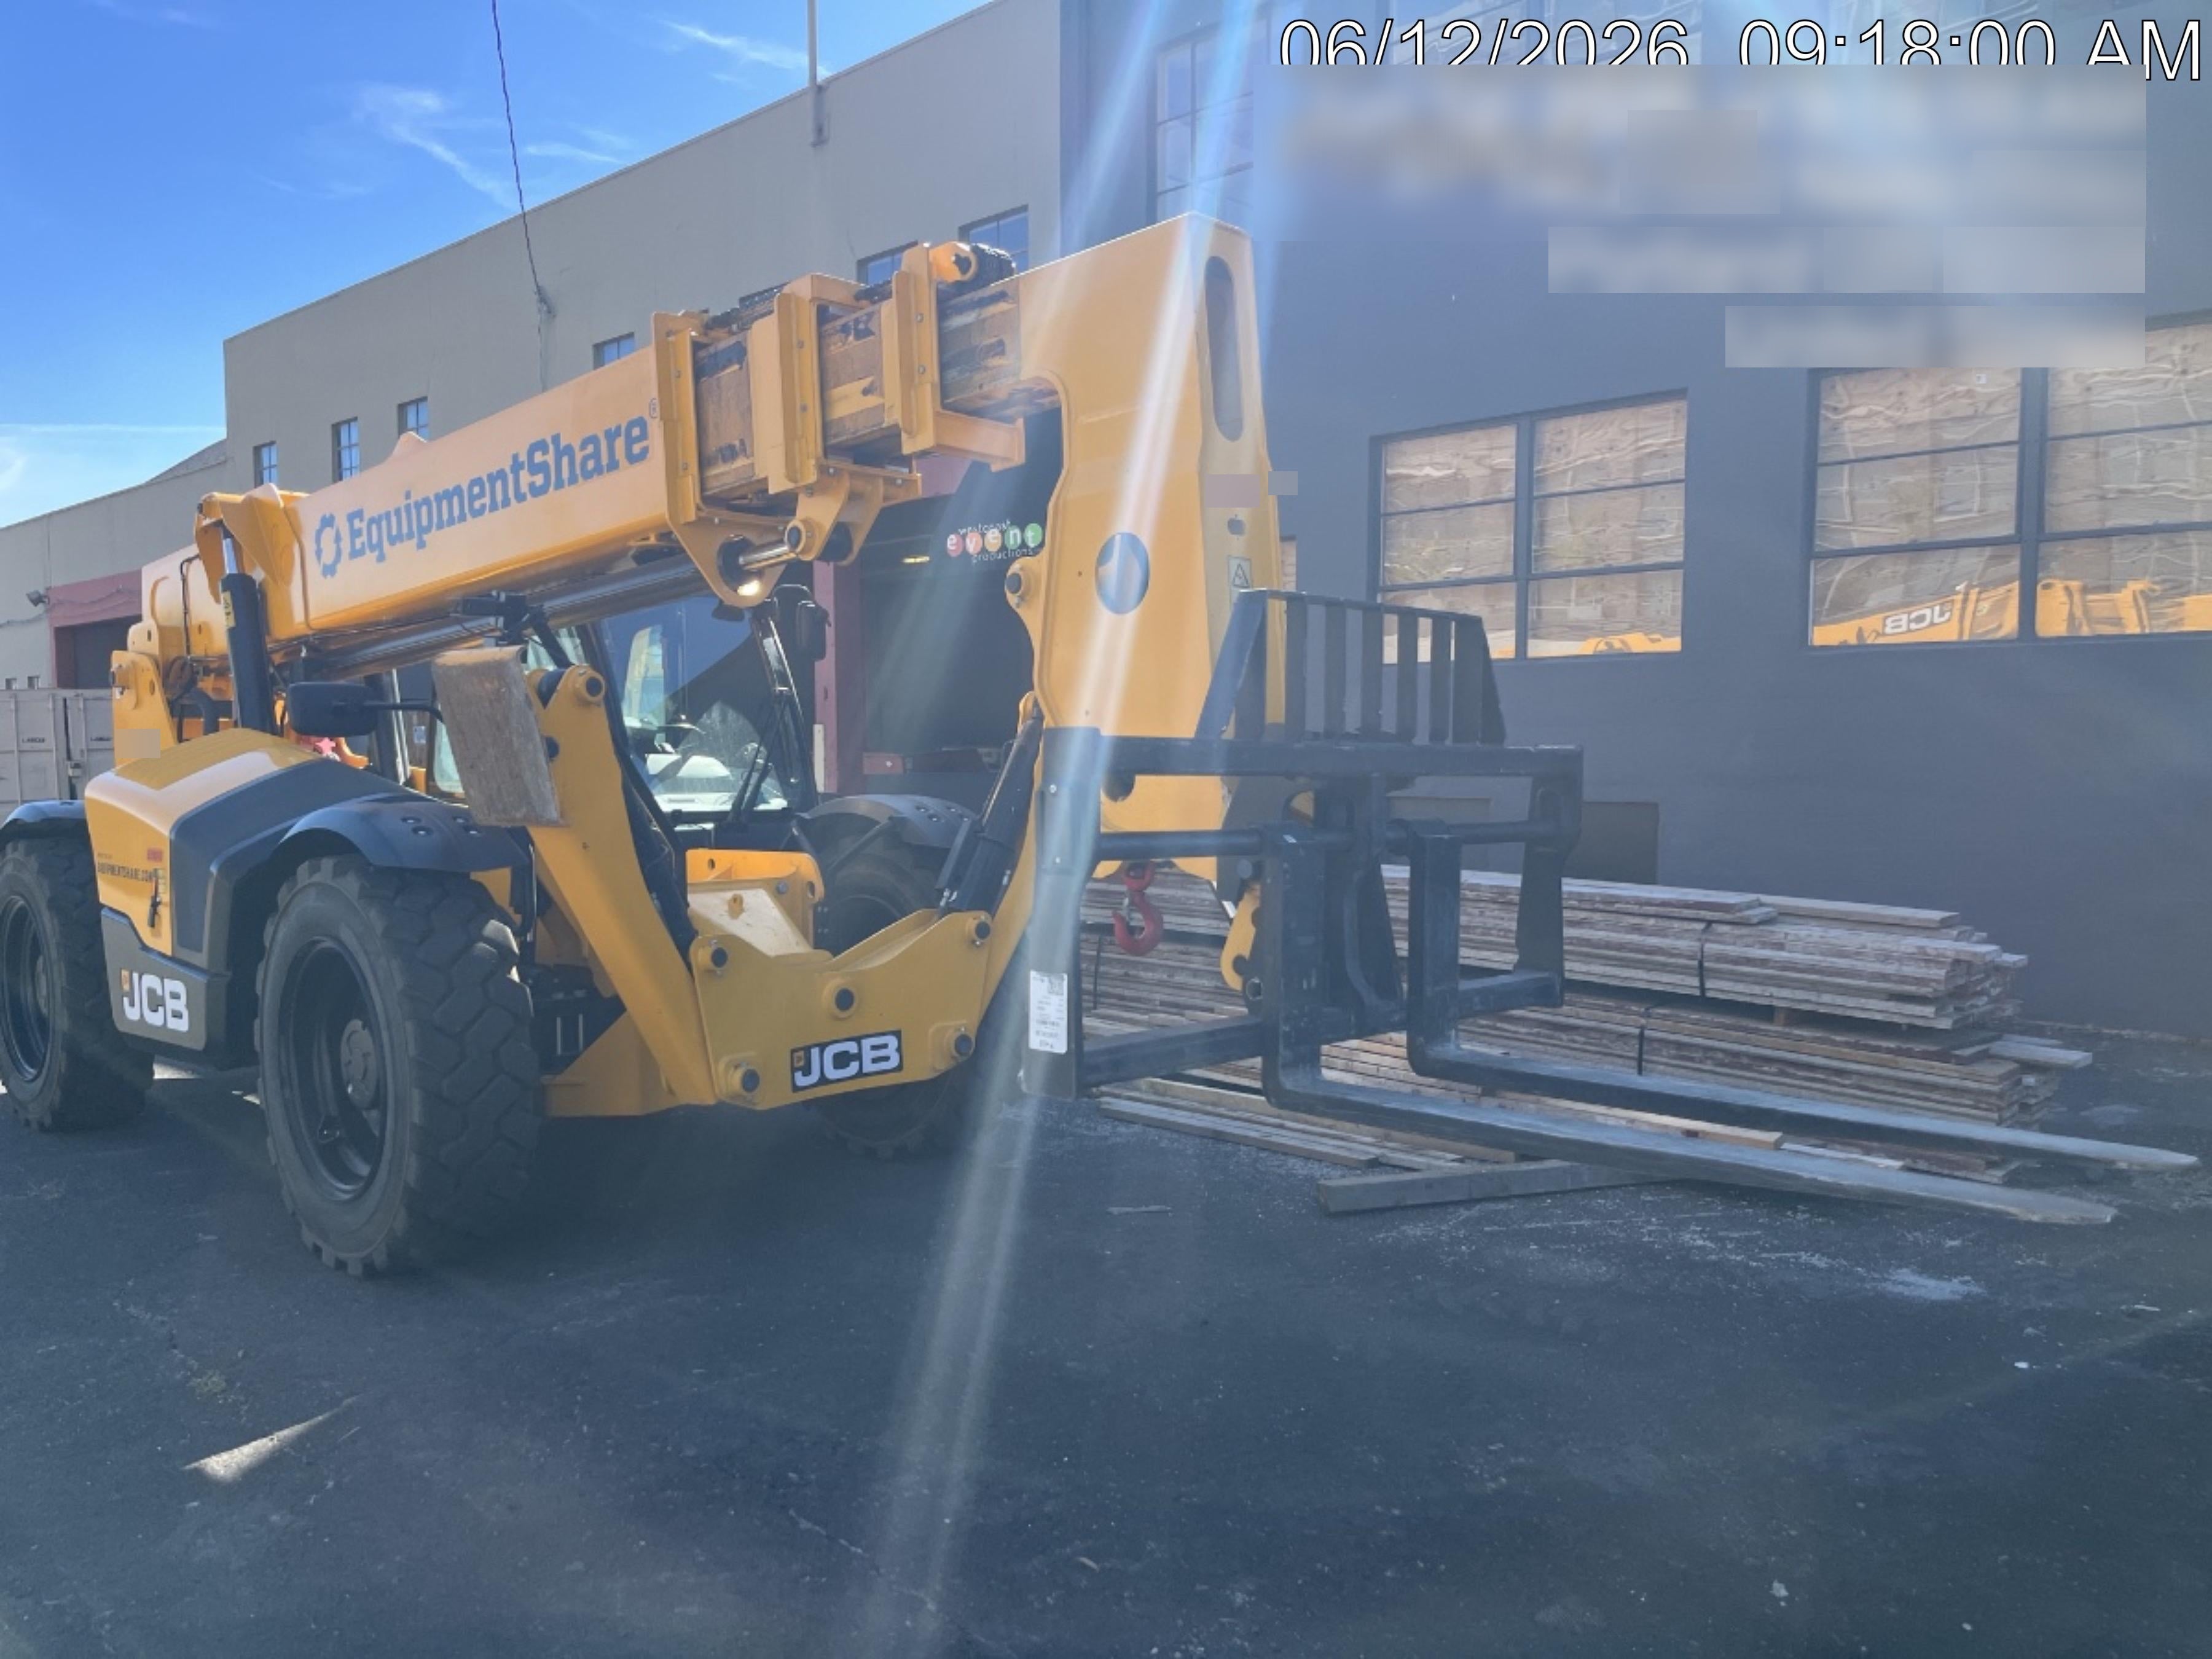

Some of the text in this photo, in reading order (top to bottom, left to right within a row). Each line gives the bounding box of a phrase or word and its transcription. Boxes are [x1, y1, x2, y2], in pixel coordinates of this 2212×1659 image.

[346, 414, 650, 563] EquipmentShare
[947, 526, 1040, 554] event
[123, 971, 189, 1032] JCB
[794, 1035, 900, 1086] JCB
